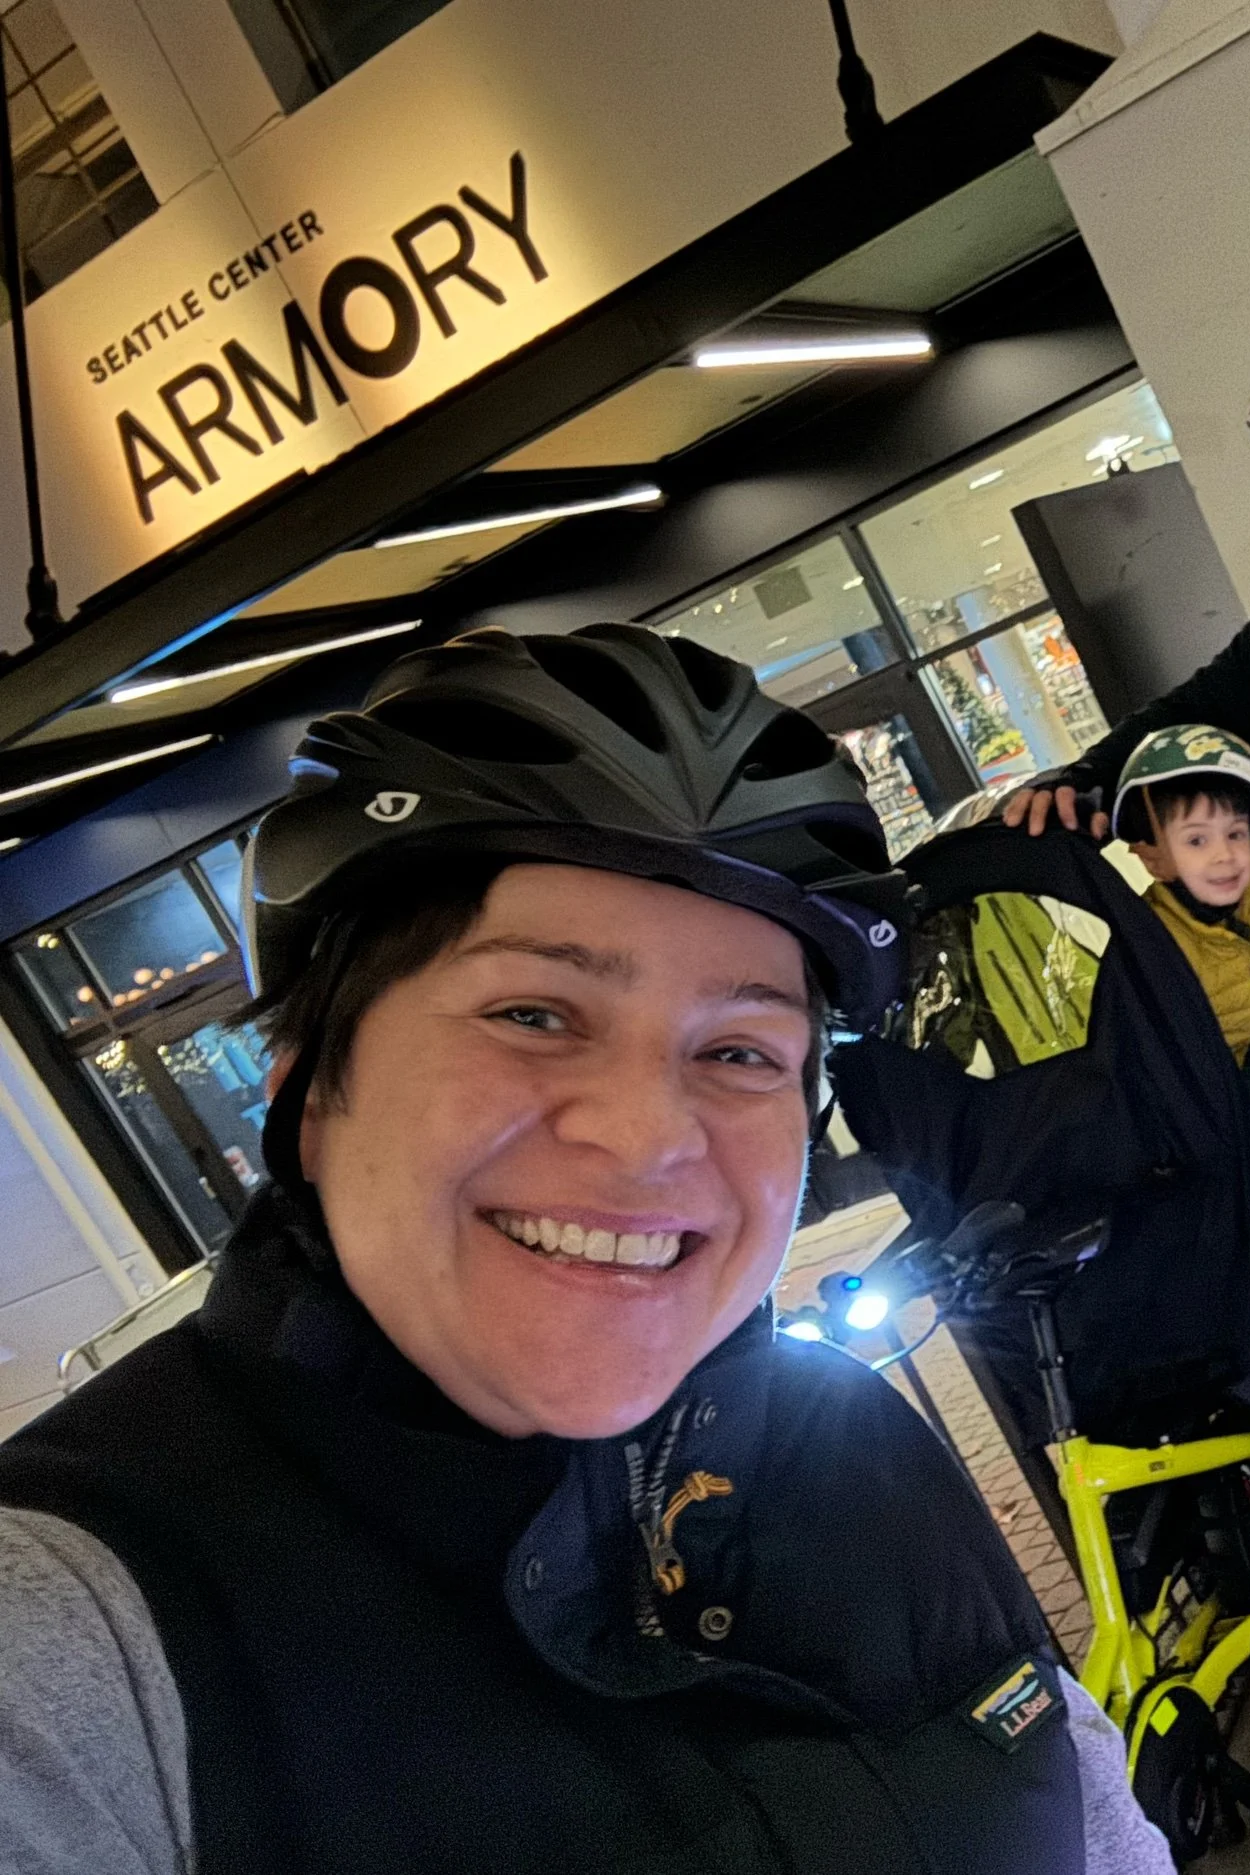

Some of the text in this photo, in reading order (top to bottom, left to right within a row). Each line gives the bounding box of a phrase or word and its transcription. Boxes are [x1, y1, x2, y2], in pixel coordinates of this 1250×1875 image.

[86, 209, 324, 384] SEATTLE CENTER
[115, 149, 549, 525] ARMORY
